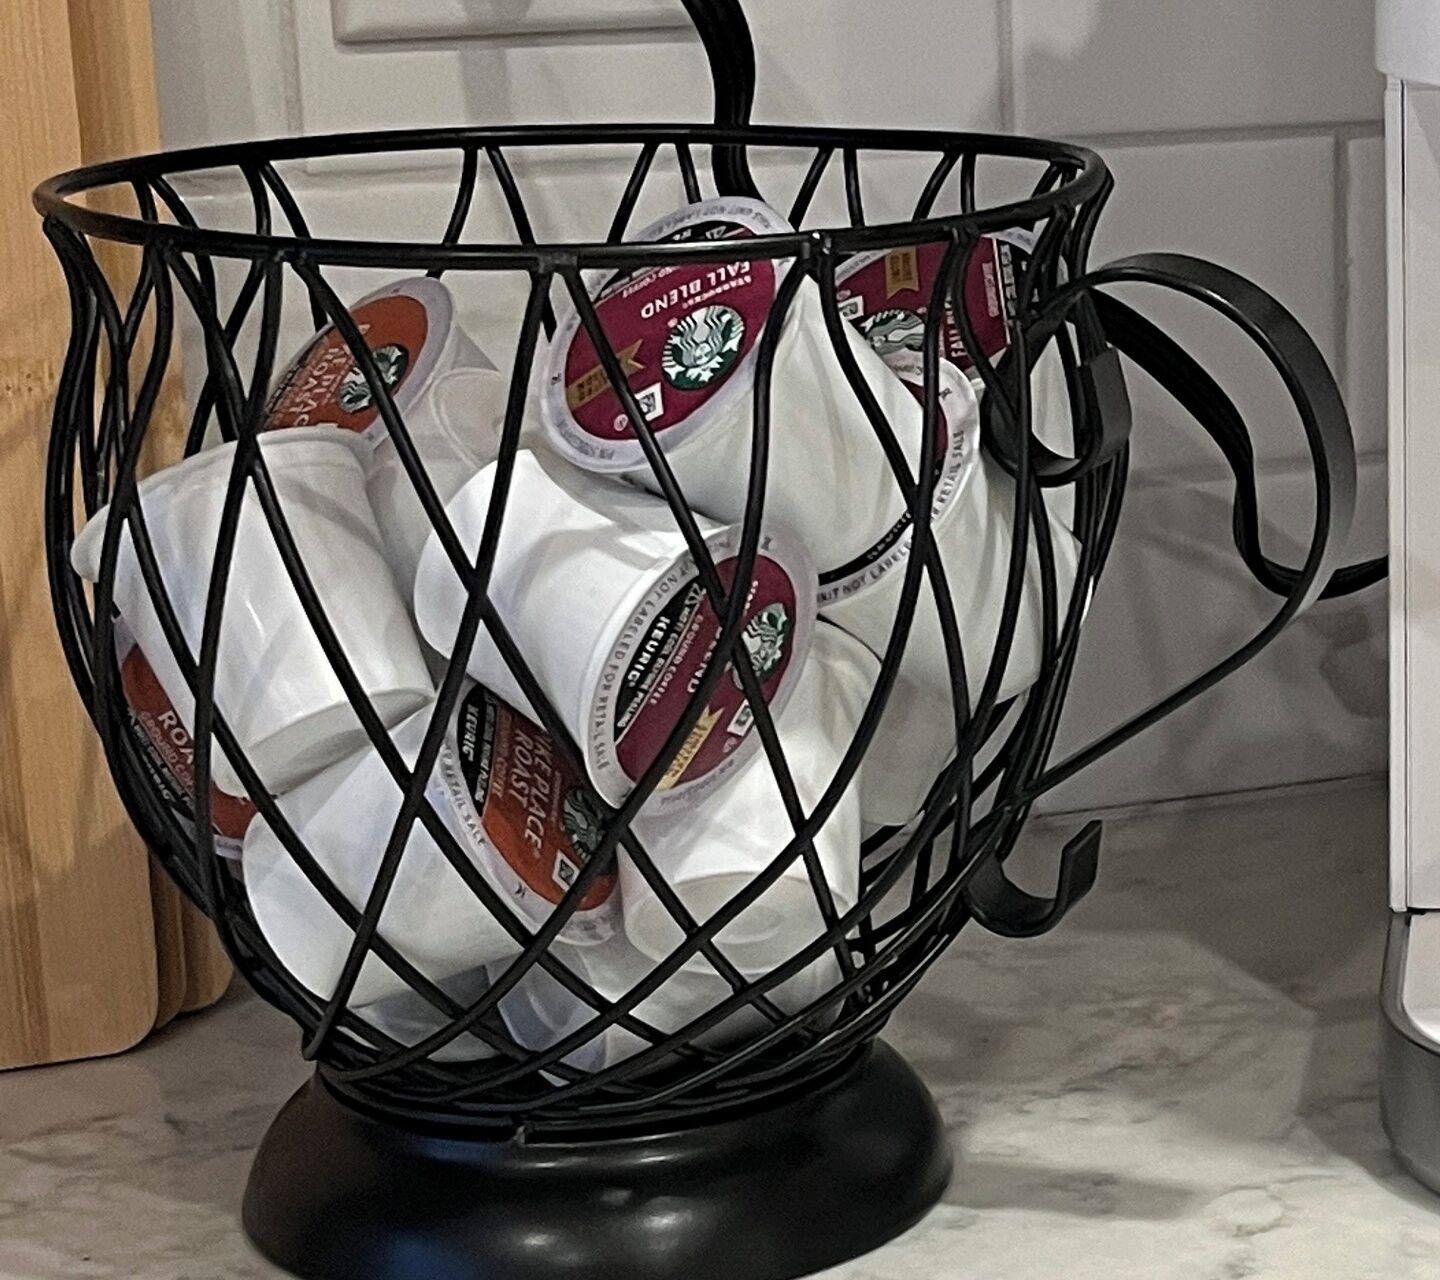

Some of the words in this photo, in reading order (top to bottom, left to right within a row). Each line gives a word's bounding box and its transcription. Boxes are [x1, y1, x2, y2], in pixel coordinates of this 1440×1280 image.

[640, 279, 702, 318] BLEND
[706, 261, 751, 287] FALL
[626, 615, 672, 683] KEURIG
[508, 729, 535, 809] ROAST
[524, 773, 551, 850] PLACE
